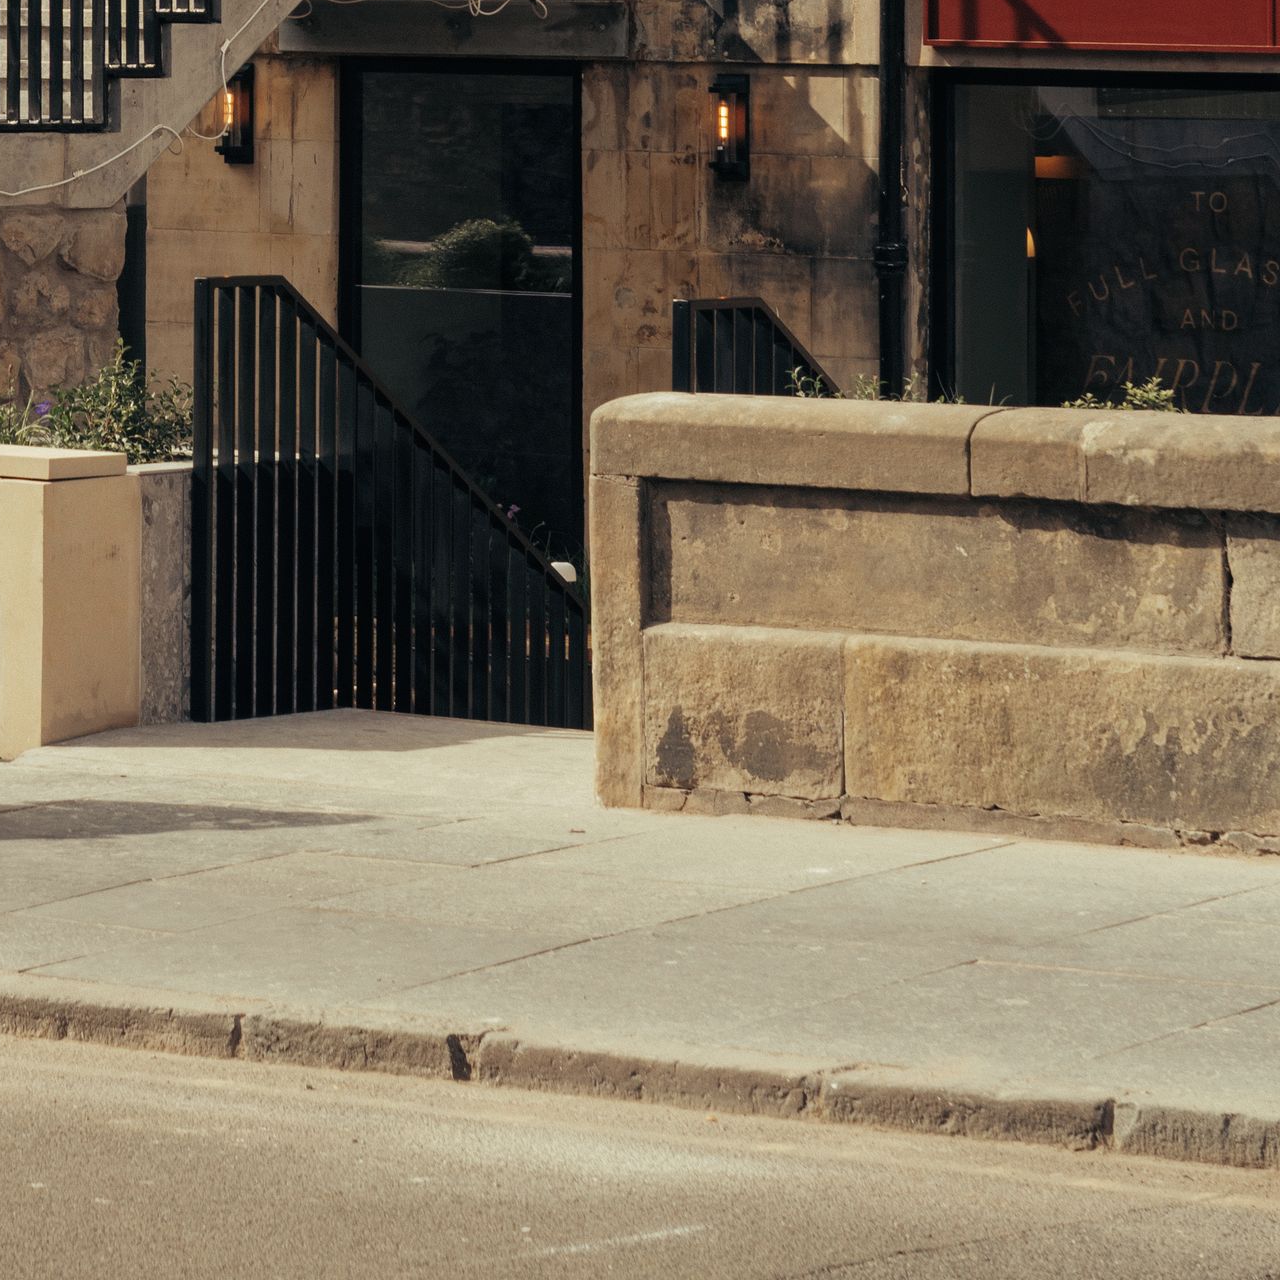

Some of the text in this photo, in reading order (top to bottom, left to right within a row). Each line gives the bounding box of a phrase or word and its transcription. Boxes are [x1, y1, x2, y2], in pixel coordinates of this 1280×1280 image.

[1191, 191, 1228, 214] TO
[1068, 256, 1158, 317] FULL
[1180, 308, 1239, 331] AND
[1082, 353, 1280, 416] FARPL
